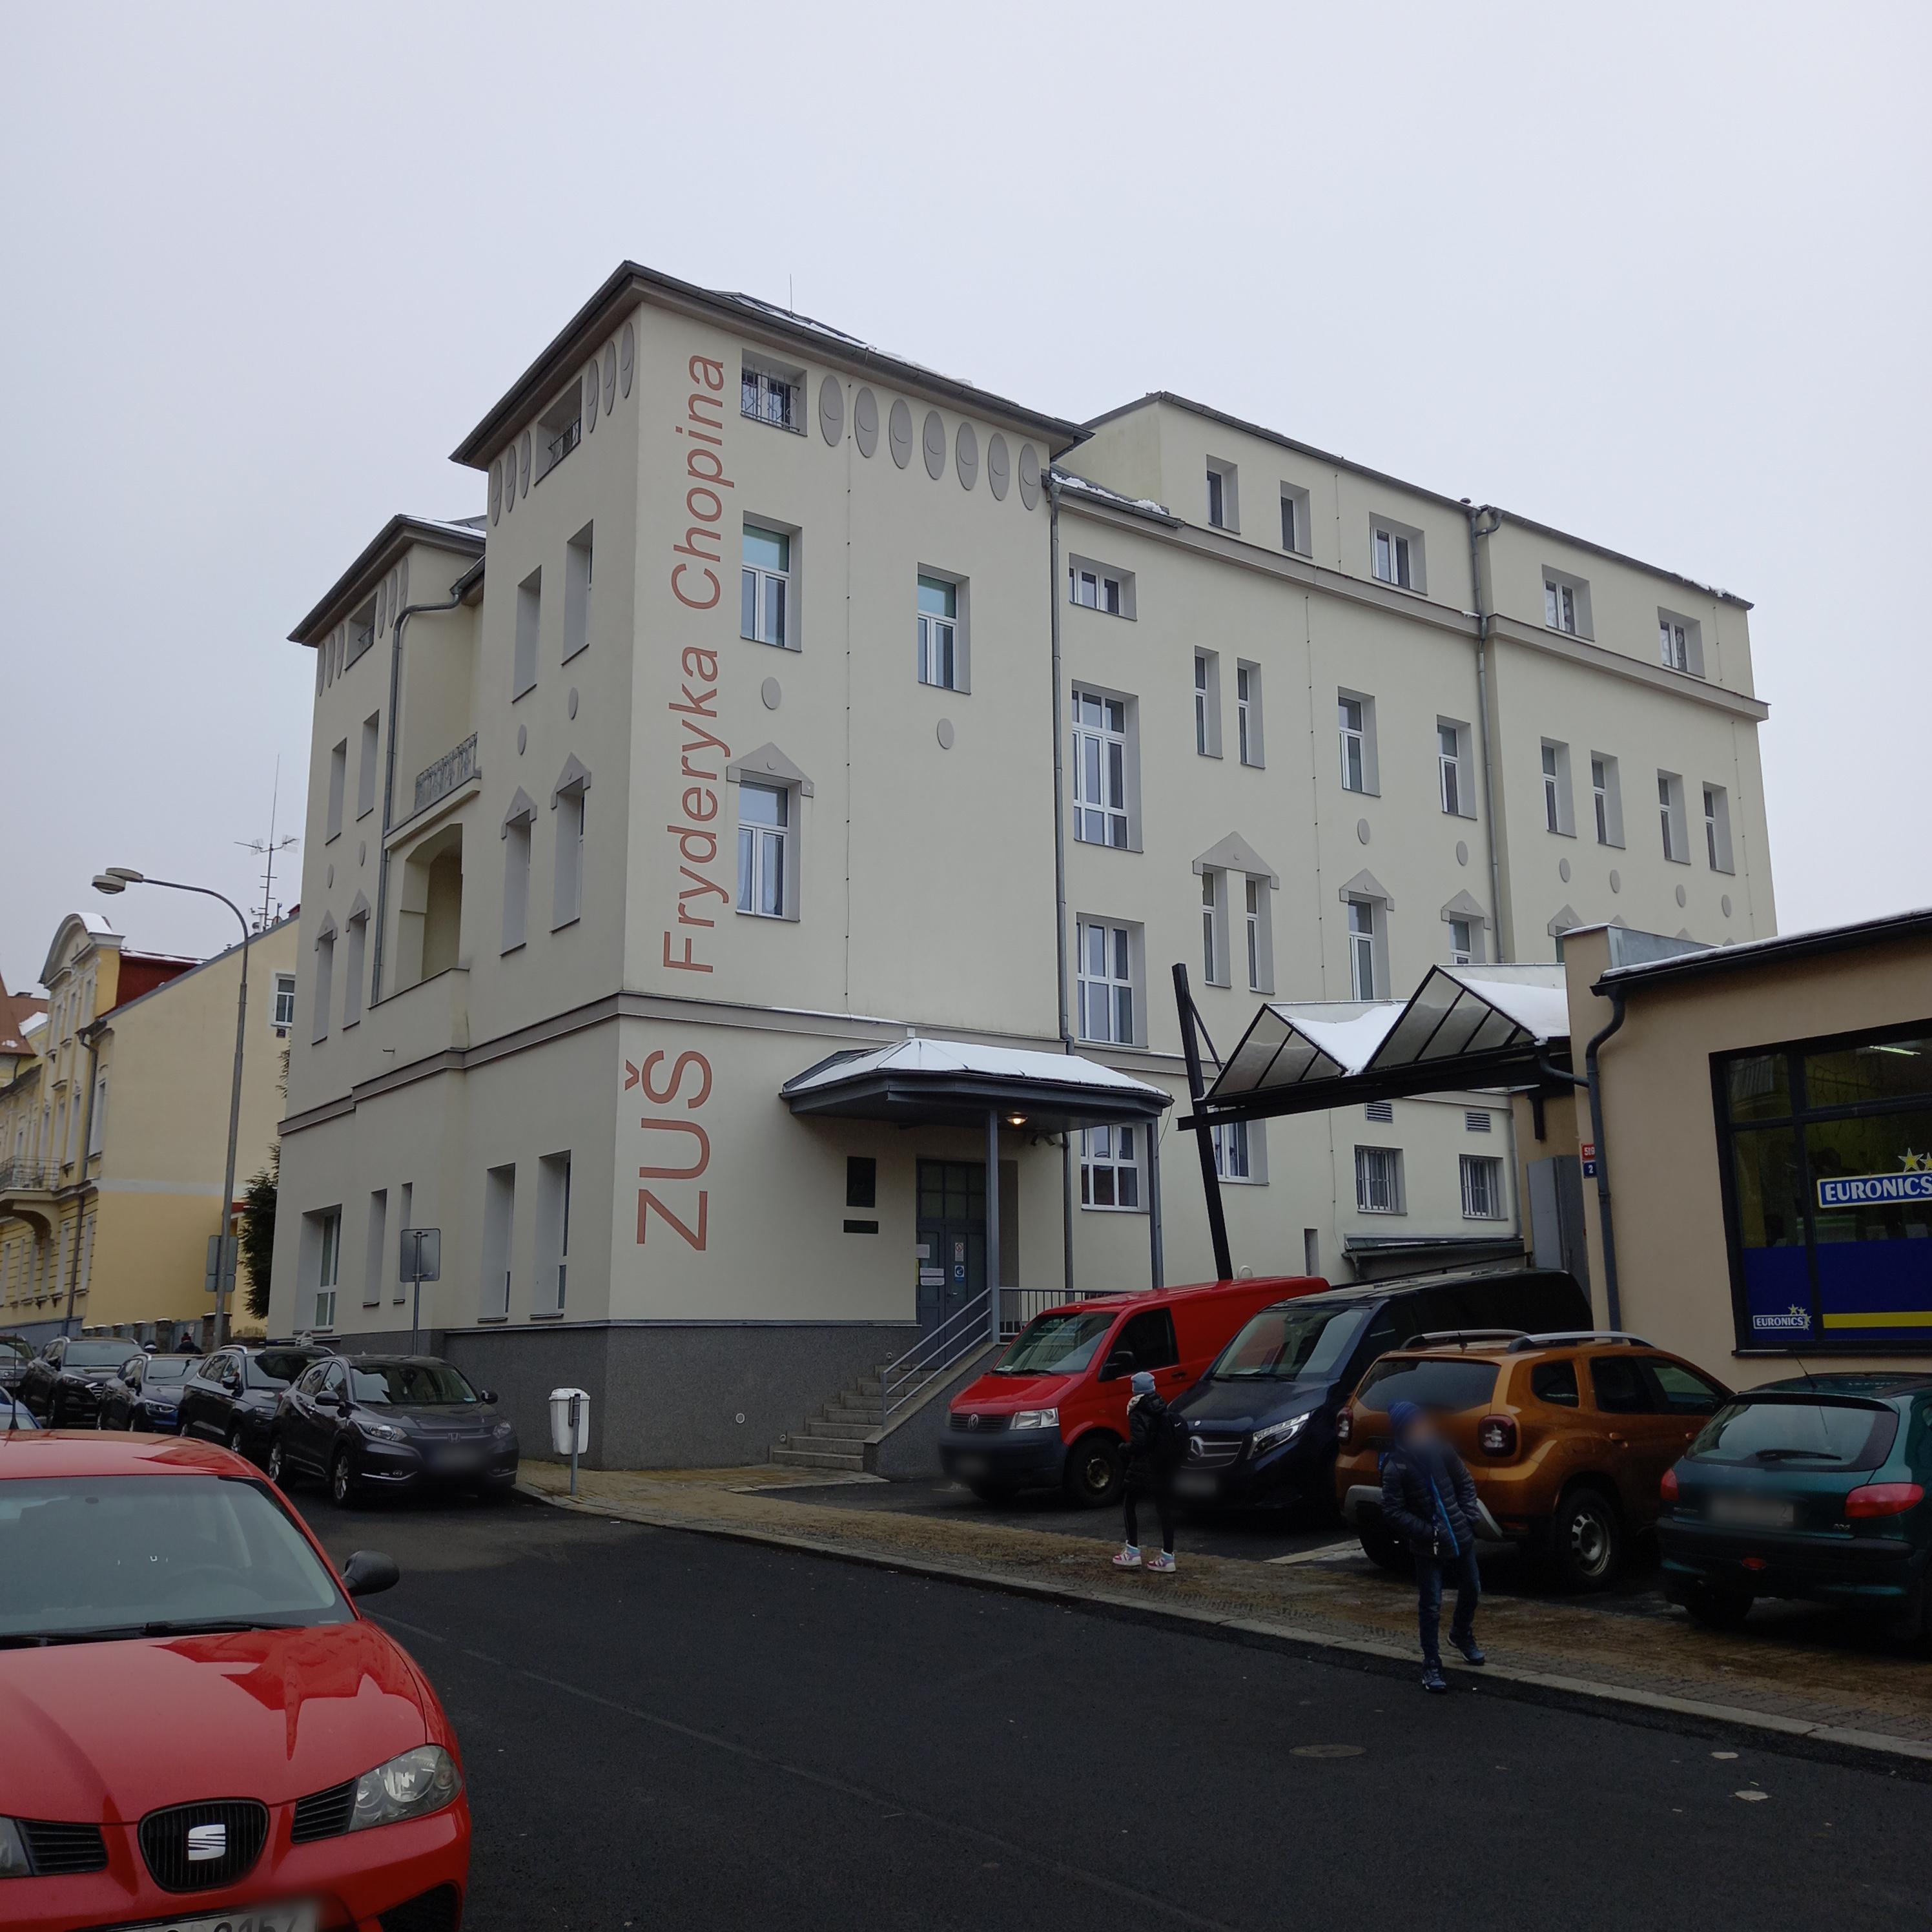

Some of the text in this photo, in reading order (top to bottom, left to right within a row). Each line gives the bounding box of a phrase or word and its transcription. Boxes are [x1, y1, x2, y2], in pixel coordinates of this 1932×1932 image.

[663, 354, 734, 973] Fryderyka Chopina
[624, 1050, 712, 1251] ZUŠ
[1588, 1164, 1594, 1174] 2
[1825, 1176, 1932, 1201] EURONICS
[1756, 1316, 1804, 1327] EURONICS
